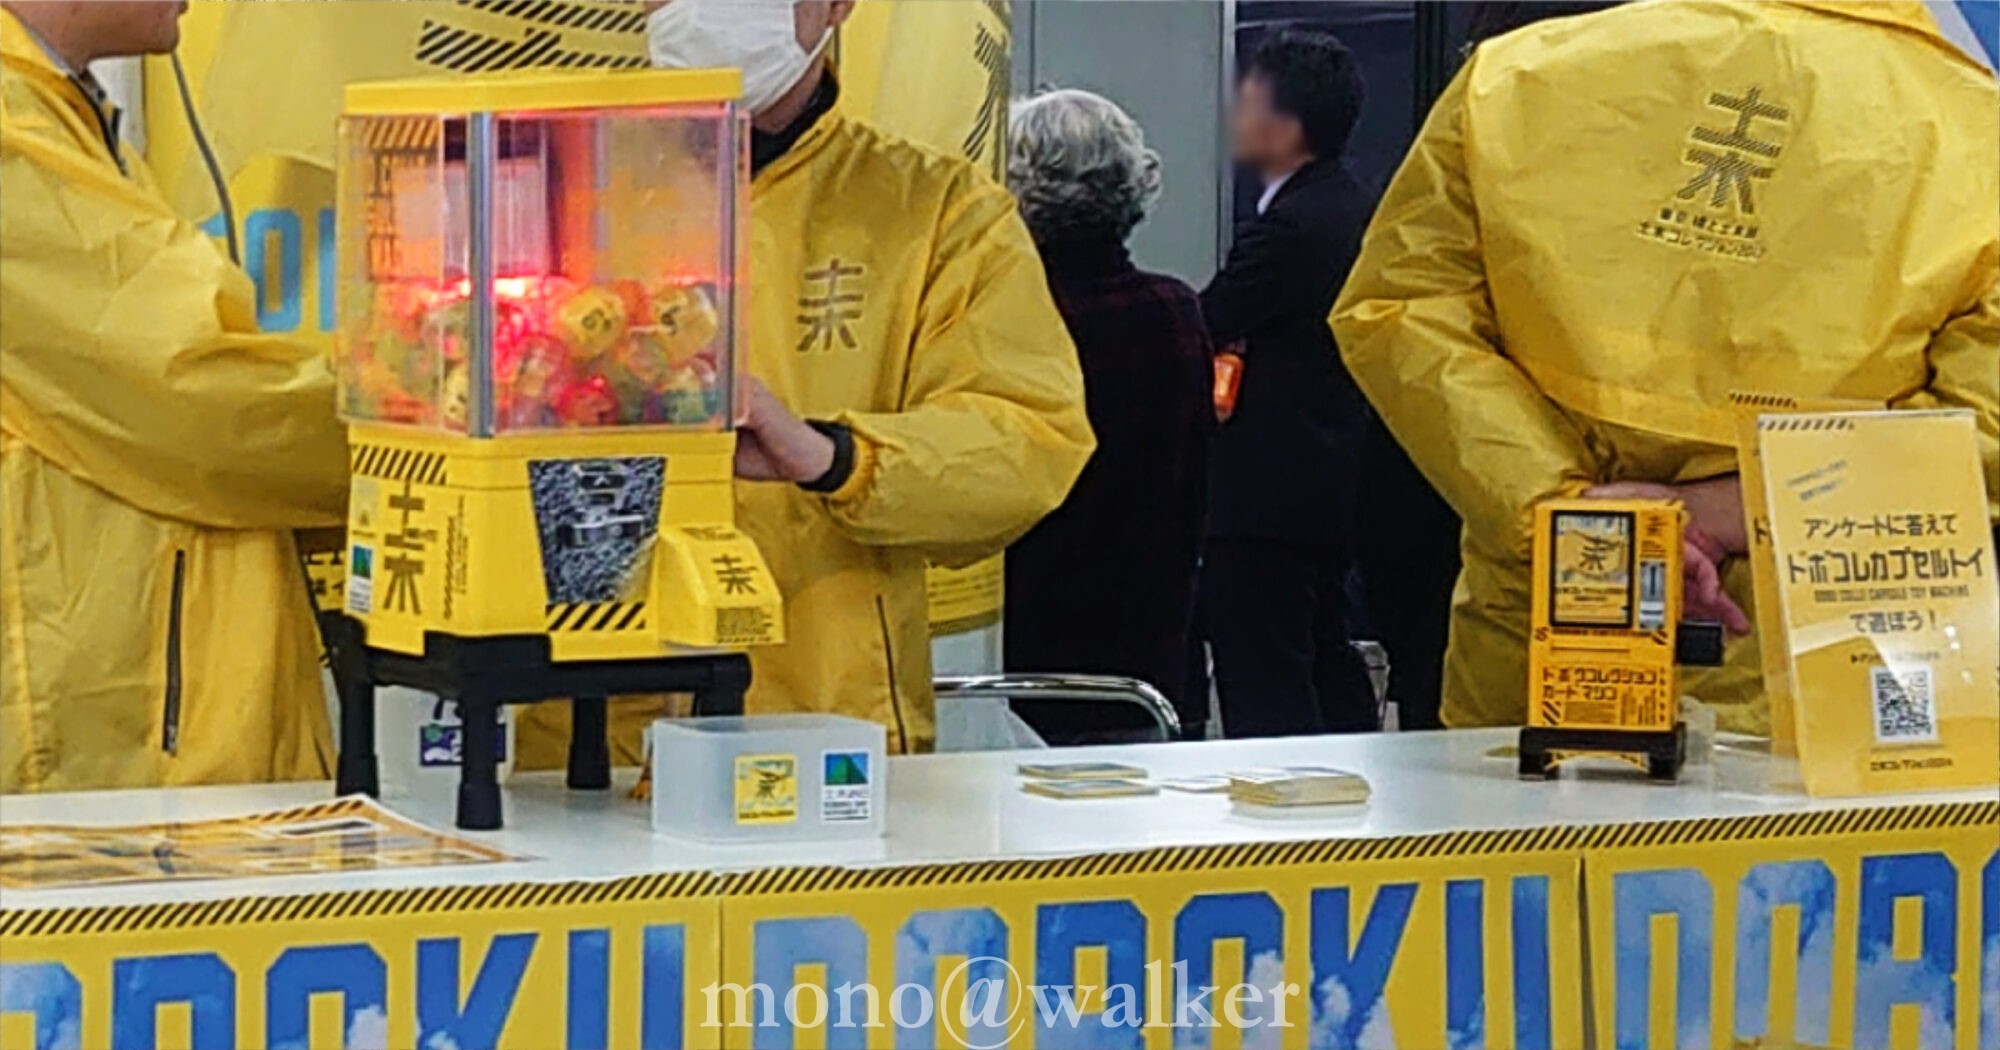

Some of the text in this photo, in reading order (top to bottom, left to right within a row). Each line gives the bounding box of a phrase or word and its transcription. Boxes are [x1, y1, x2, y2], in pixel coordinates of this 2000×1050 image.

[1803, 513, 1959, 540] アンケートに答えて
[1786, 546, 1985, 586] ドボコレカプセルトイ
